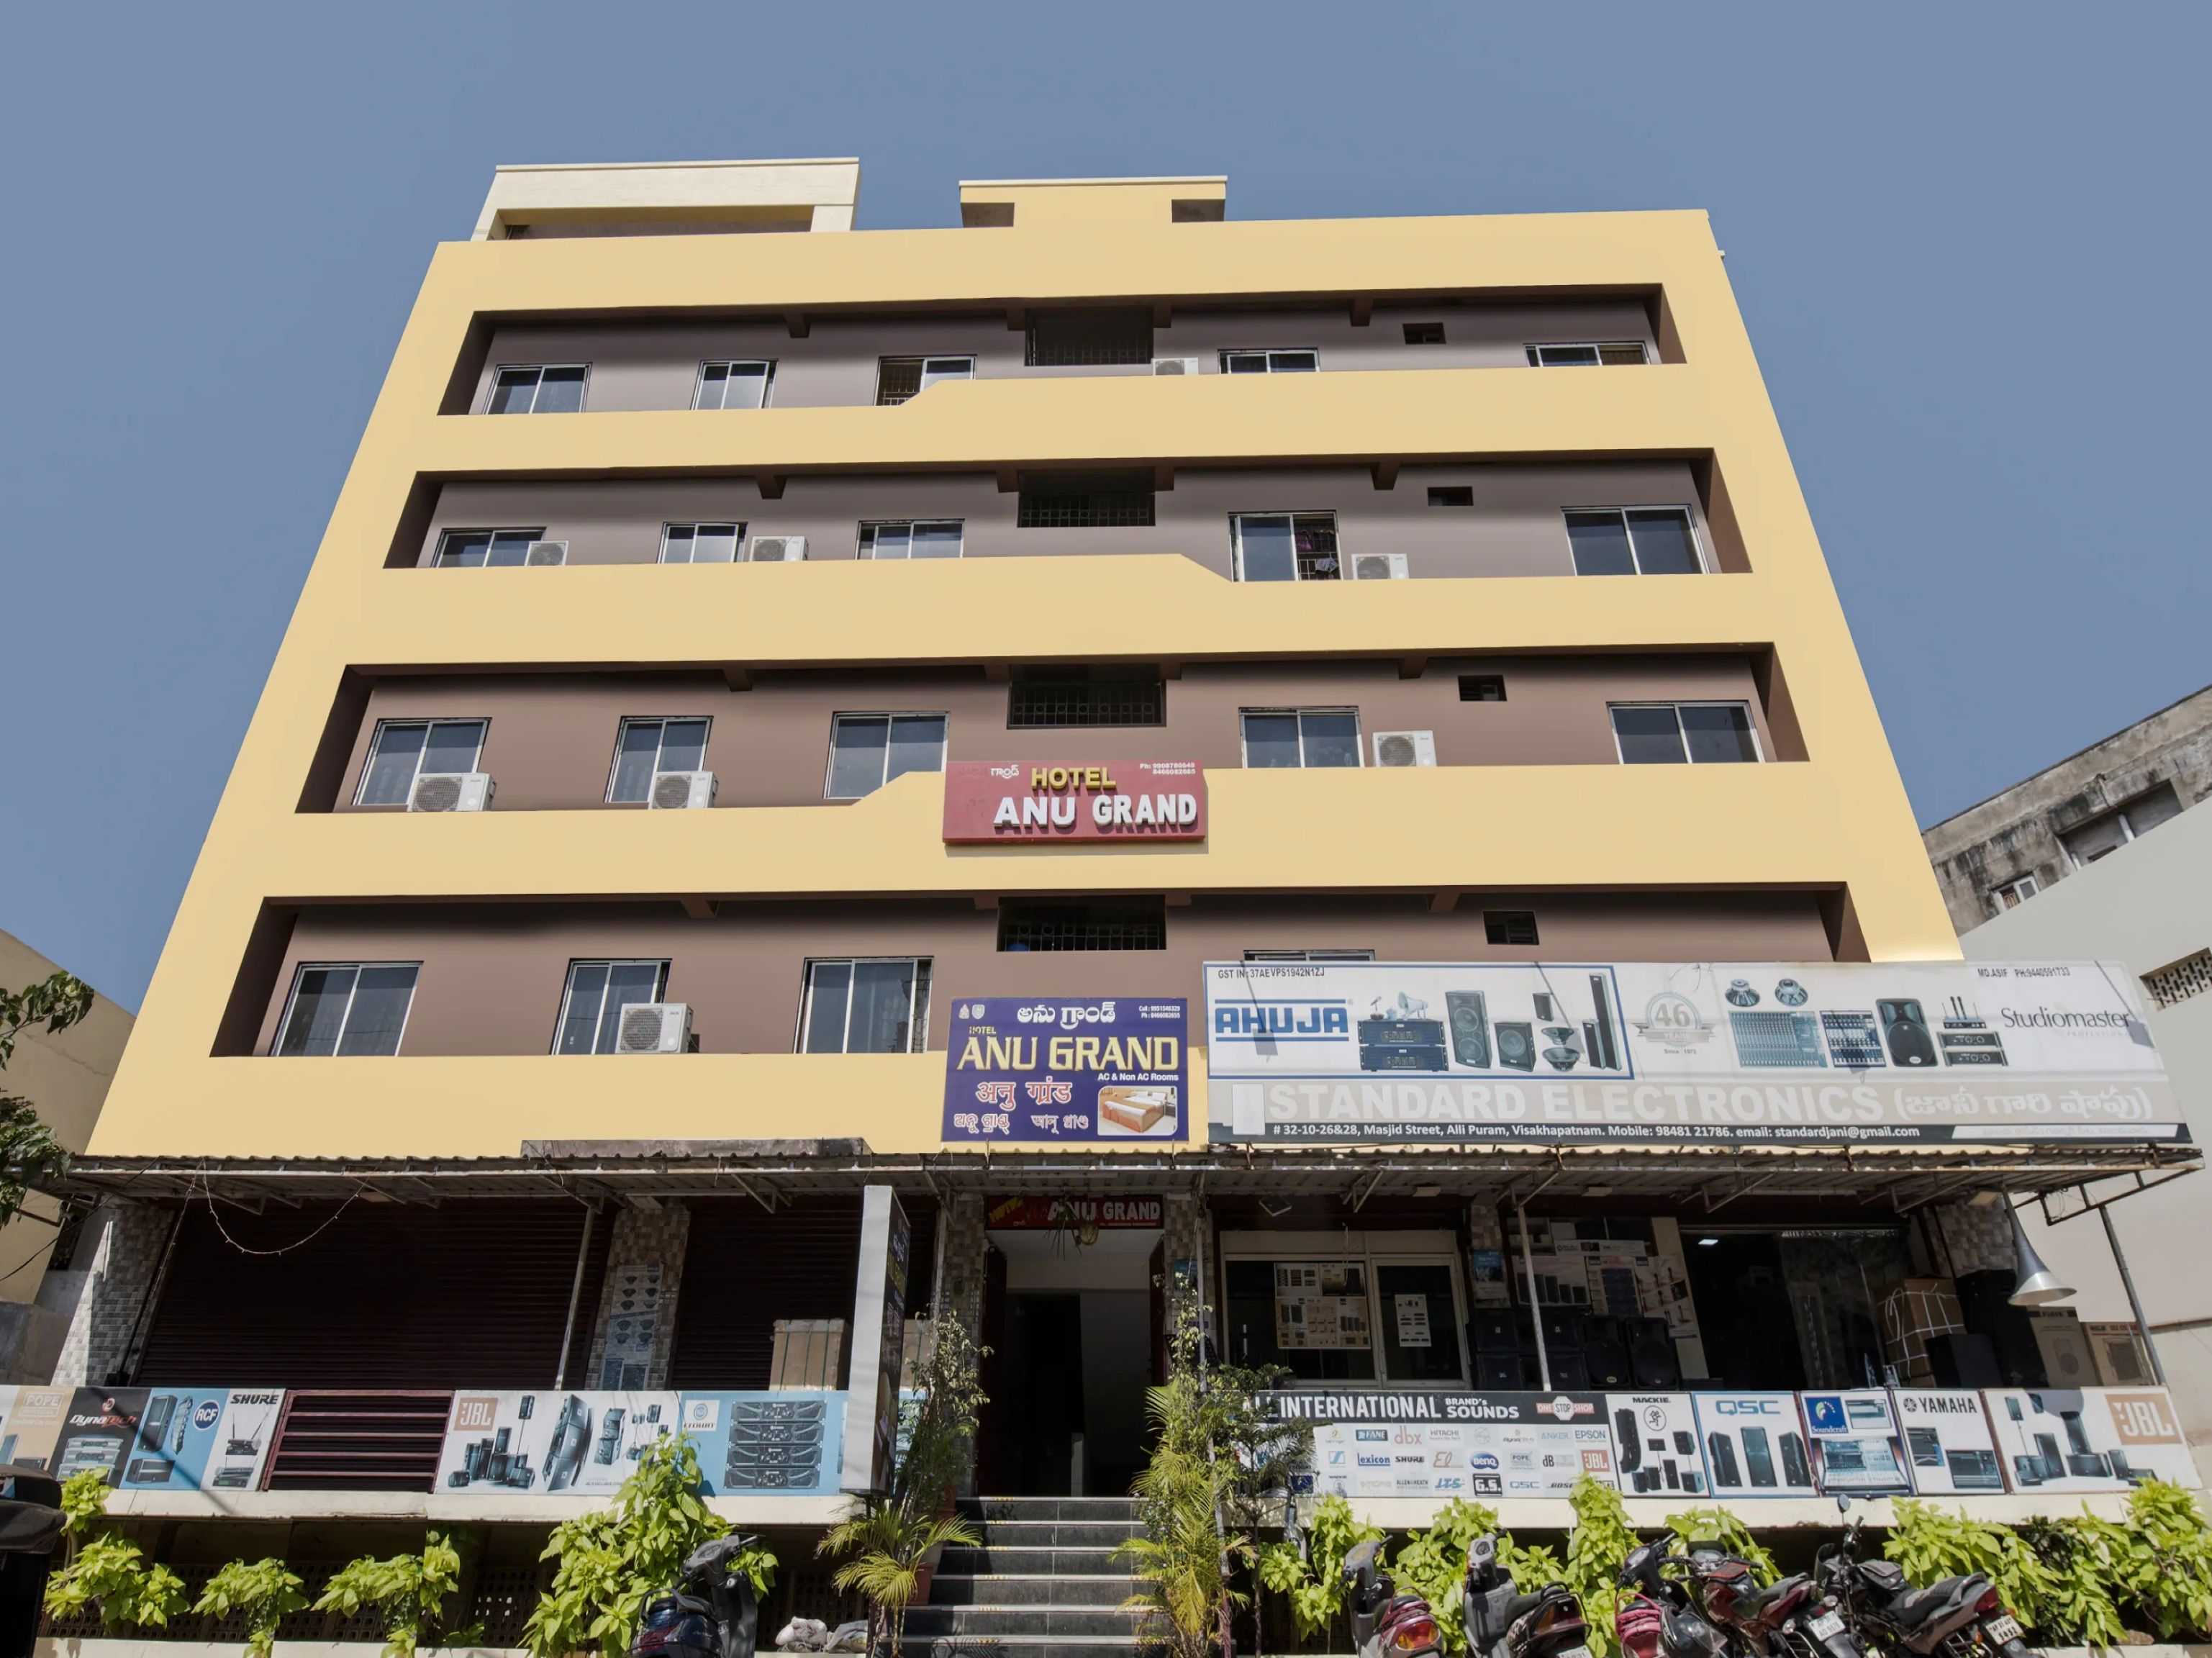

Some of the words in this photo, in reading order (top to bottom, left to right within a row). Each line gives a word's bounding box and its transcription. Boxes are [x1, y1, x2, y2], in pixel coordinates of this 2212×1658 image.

[1031, 767, 1117, 789] HOTEL
[993, 796, 1076, 828] ANU
[1092, 794, 1197, 827] GRAND
[1218, 969, 1233, 979] GST
[1977, 968, 2008, 977] MD.ASIF
[1215, 1007, 1348, 1033] AHUJA
[1656, 1002, 1690, 1027] 46
[2000, 1006, 2131, 1028] Studiomaster
[956, 1036, 1038, 1071] ANU
[1048, 1036, 1179, 1072] GRAND
[976, 1082, 1016, 1111] अनु
[1269, 1084, 1526, 1120] STANDARD
[1541, 1084, 1884, 1122] ELECTRONICS
[1273, 1125, 1281, 1135] #
[1283, 1124, 1361, 1137] 32-10-26&28,
[1364, 1125, 1402, 1137] Masjid
[1405, 1125, 1443, 1137] Street,
[1446, 1125, 1466, 1136] Alli
[1469, 1125, 1510, 1138] Puram,
[1511, 1125, 1605, 1138] Visakhapatnam.
[1608, 1125, 1654, 1137] Mobile:
[1656, 1126, 1692, 1137] 98481
[1736, 1126, 1773, 1138] email:
[1774, 1126, 1921, 1140] standardjani@gmail.com
[1102, 1200, 1160, 1221] GRAND
[27, 1394, 60, 1405] POPE
[230, 1394, 280, 1405] SHURE
[1281, 1396, 1441, 1418] INTERNATIONAL
[1538, 1404, 1554, 1413] ONE
[1555, 1403, 1572, 1413] STOP
[1574, 1404, 1594, 1413] SHOP
[1715, 1400, 1781, 1416] QSC
[1918, 1397, 1977, 1414] YAMAHA
[196, 1408, 217, 1422] RCF
[461, 1403, 493, 1427] JBL
[1447, 1406, 1520, 1419] SOUNDS
[2114, 1402, 2175, 1437] JBL
[1394, 1426, 1423, 1444] dbx
[1574, 1430, 1607, 1440] EPSON
[1543, 1454, 1554, 1467] dB
[1584, 1453, 1608, 1469] JBL
